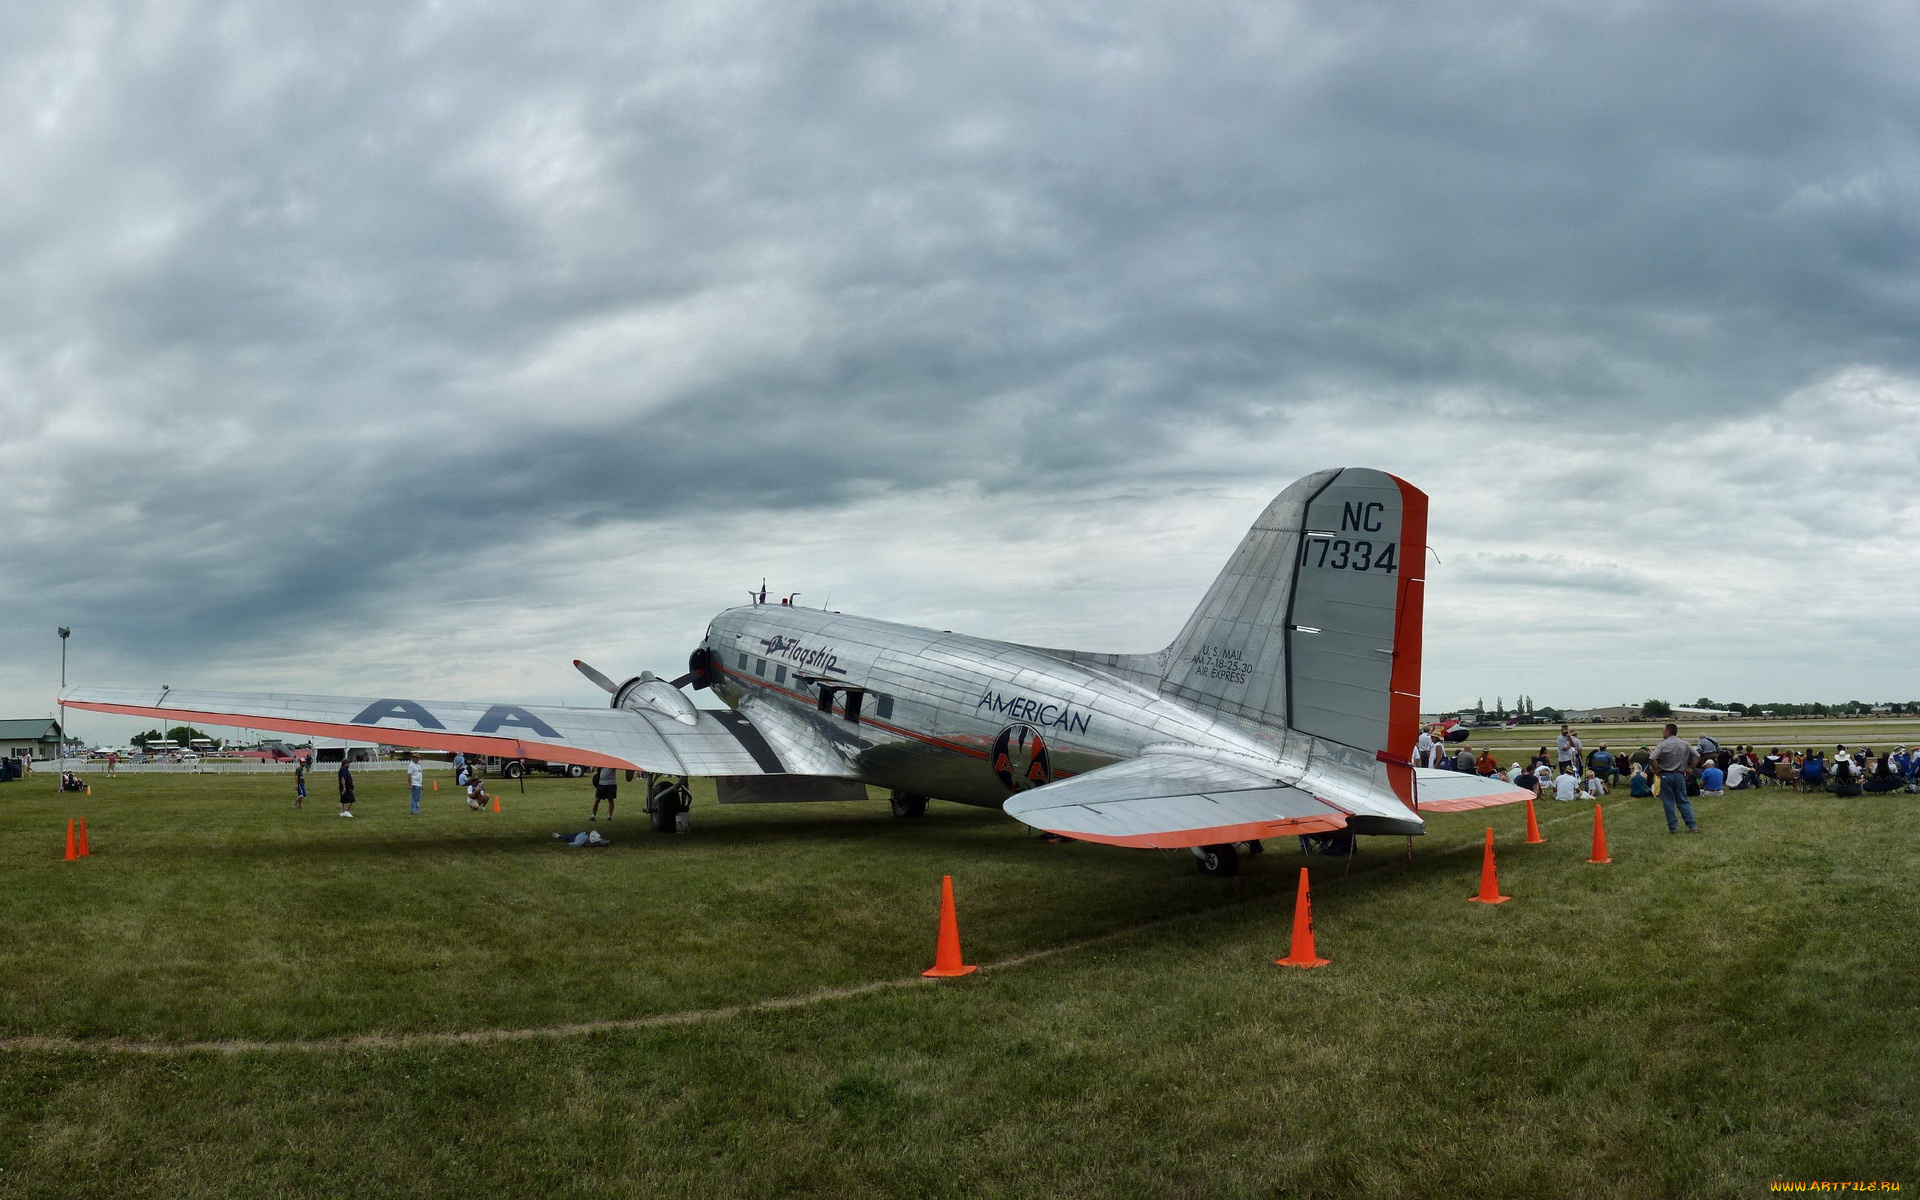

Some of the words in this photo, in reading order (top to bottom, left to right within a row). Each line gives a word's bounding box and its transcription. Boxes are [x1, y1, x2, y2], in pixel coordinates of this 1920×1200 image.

[1341, 501, 1384, 532] NC
[1302, 538, 1397, 574] 17334
[781, 638, 838, 674] Flagship
[1222, 649, 1242, 661] MAIL
[1195, 666, 1209, 677] AIR
[1211, 668, 1246, 684] EXPRESS
[978, 690, 1092, 736] AMERICAN
